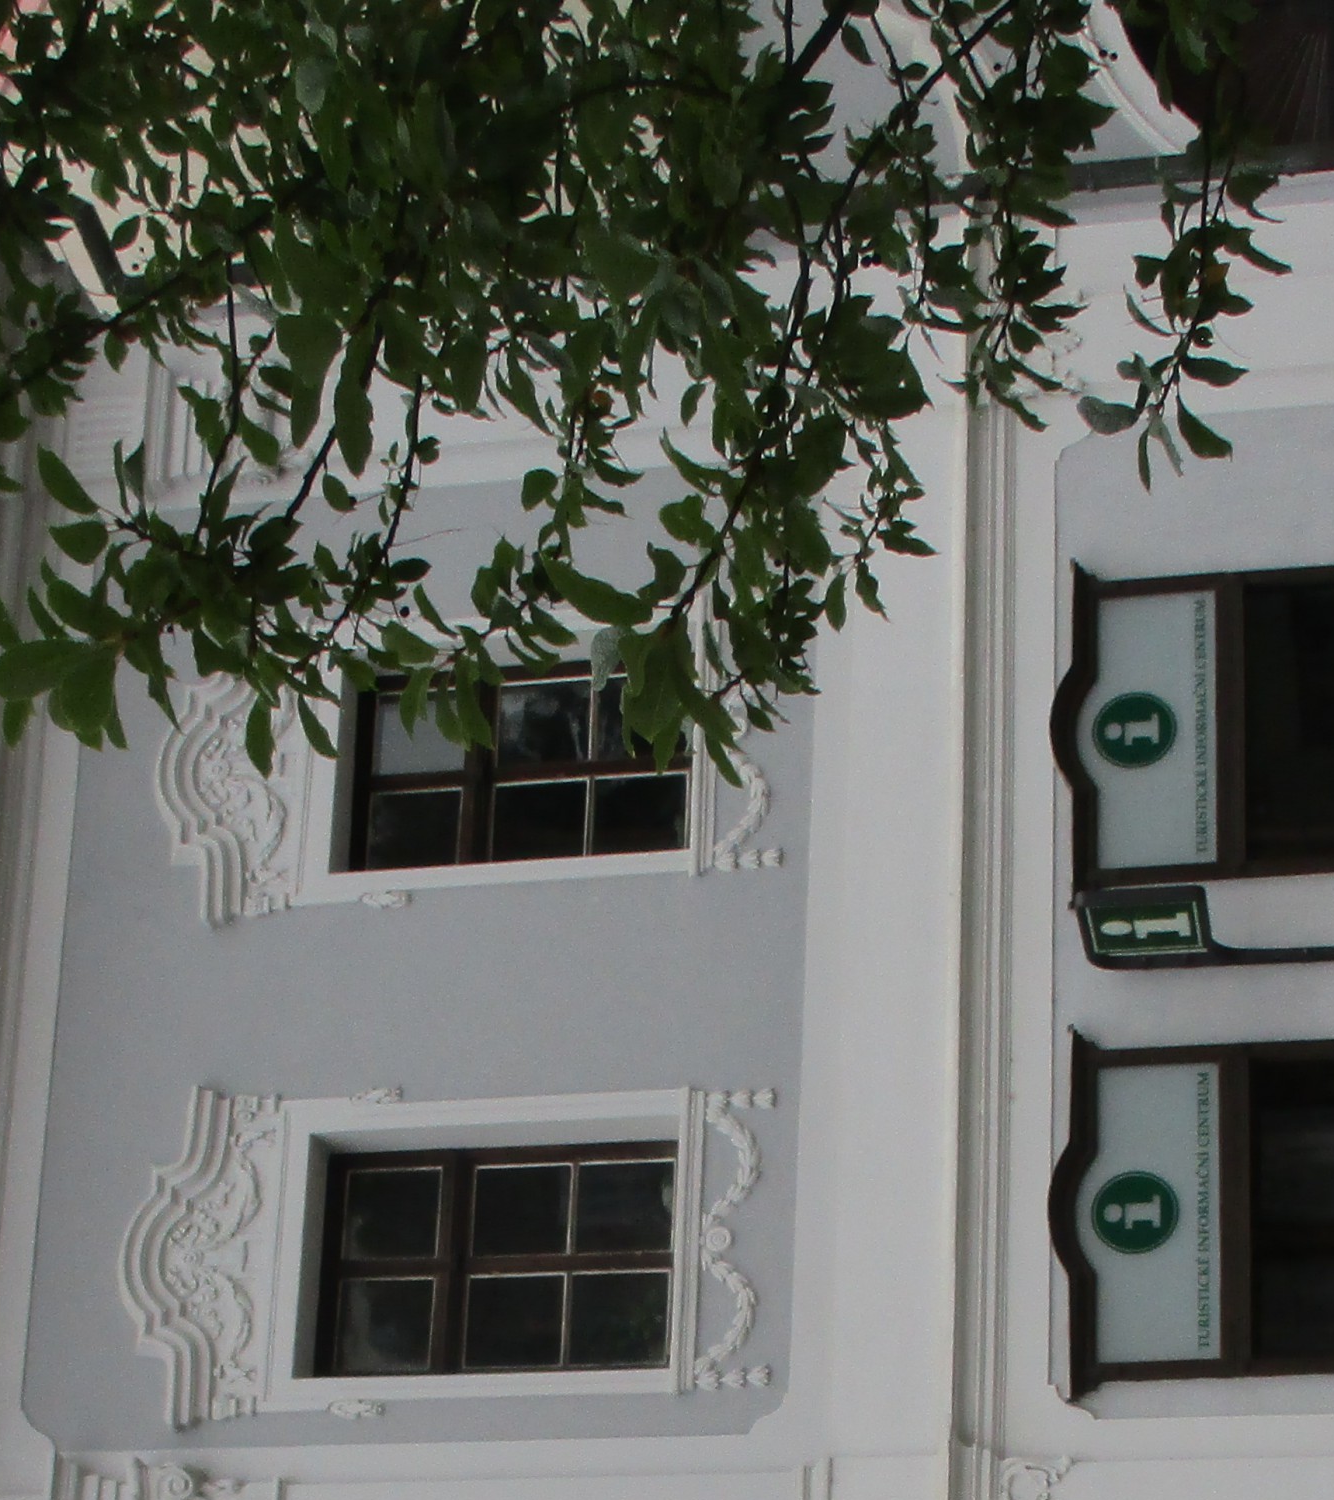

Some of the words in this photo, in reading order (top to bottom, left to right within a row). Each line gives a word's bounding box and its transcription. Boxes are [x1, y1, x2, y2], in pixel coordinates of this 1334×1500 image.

[1193, 600, 1207, 668] CENTRUM
[1192, 671, 1208, 766] INFORMAČNÍ
[1193, 770, 1209, 853] TURISTICKÉ
[1194, 1072, 1210, 1148] CENTRUM
[1193, 1151, 1210, 1252] INFORMAČNÍ
[1194, 1257, 1211, 1350] TURISTICKÉ
